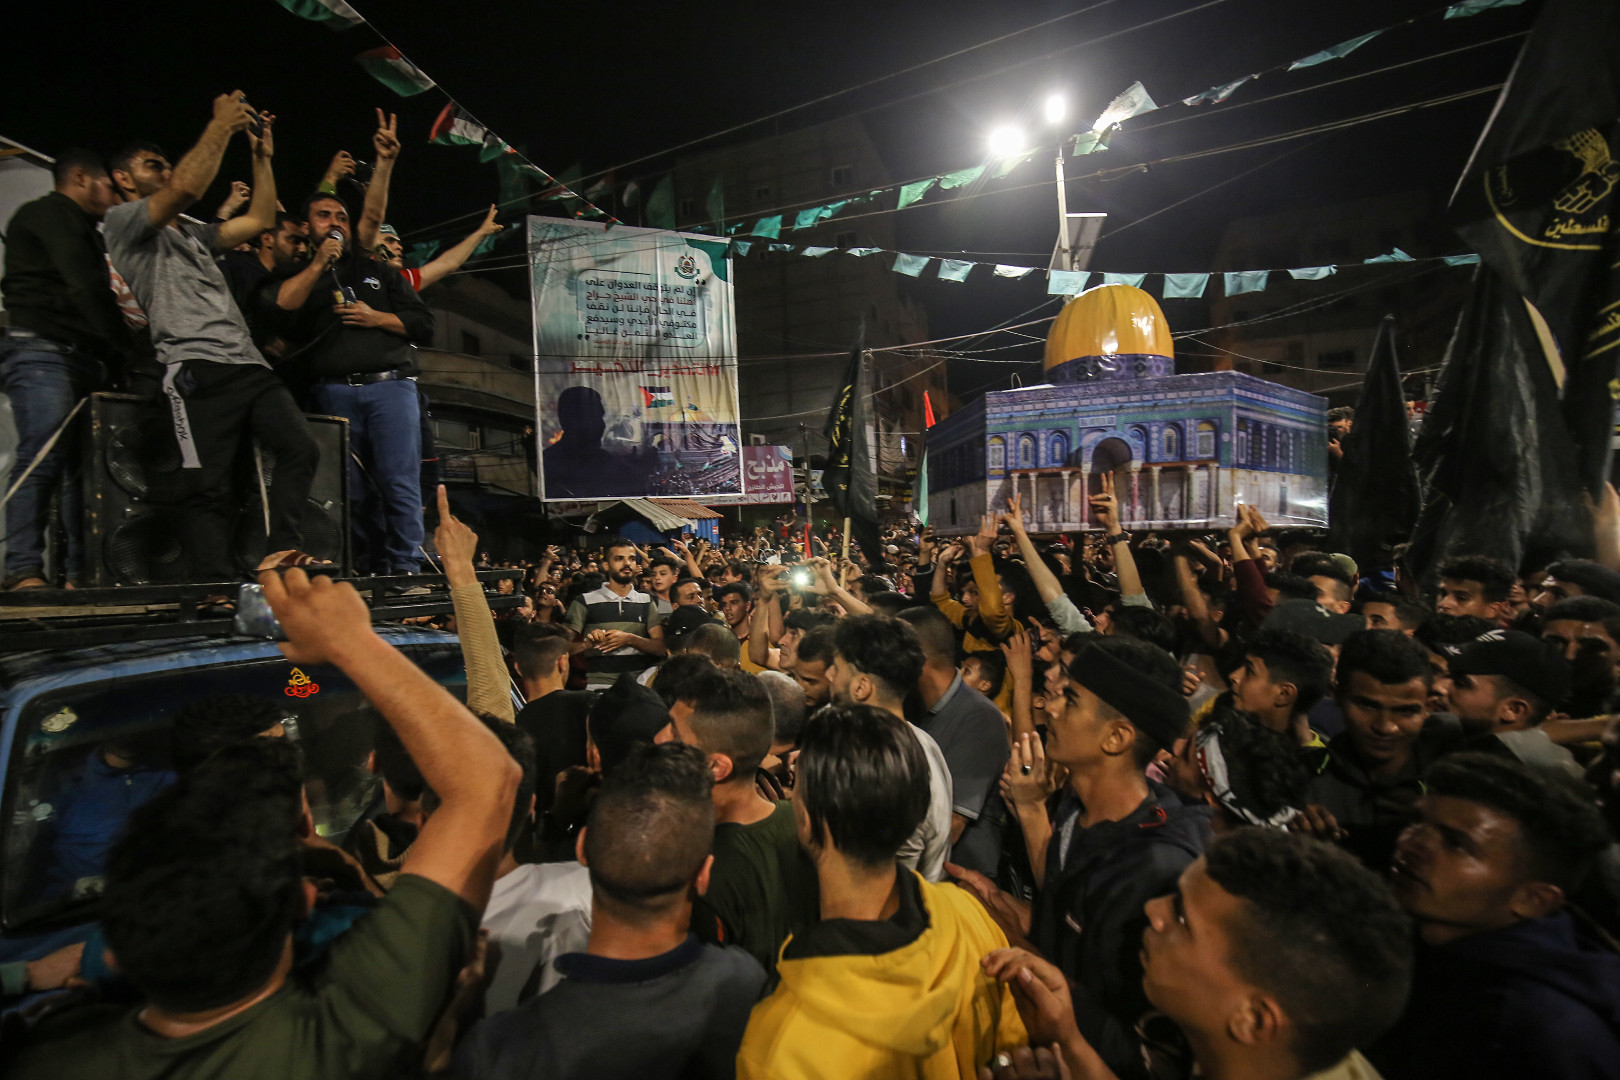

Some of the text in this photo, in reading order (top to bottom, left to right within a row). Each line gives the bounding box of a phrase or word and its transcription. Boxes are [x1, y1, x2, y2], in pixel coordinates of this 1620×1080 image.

[1544, 214, 1610, 239] فلسطين
[585, 276, 605, 287] على
[607, 279, 641, 290] العدوان
[674, 285, 684, 294] لم
[613, 291, 639, 302] الشيخ
[586, 301, 609, 311] نقف
[612, 303, 624, 313] لن
[652, 306, 674, 316] الحال
[676, 309, 696, 318] في
[586, 314, 625, 325] وسيدفع
[660, 319, 697, 329] مكتوفي
